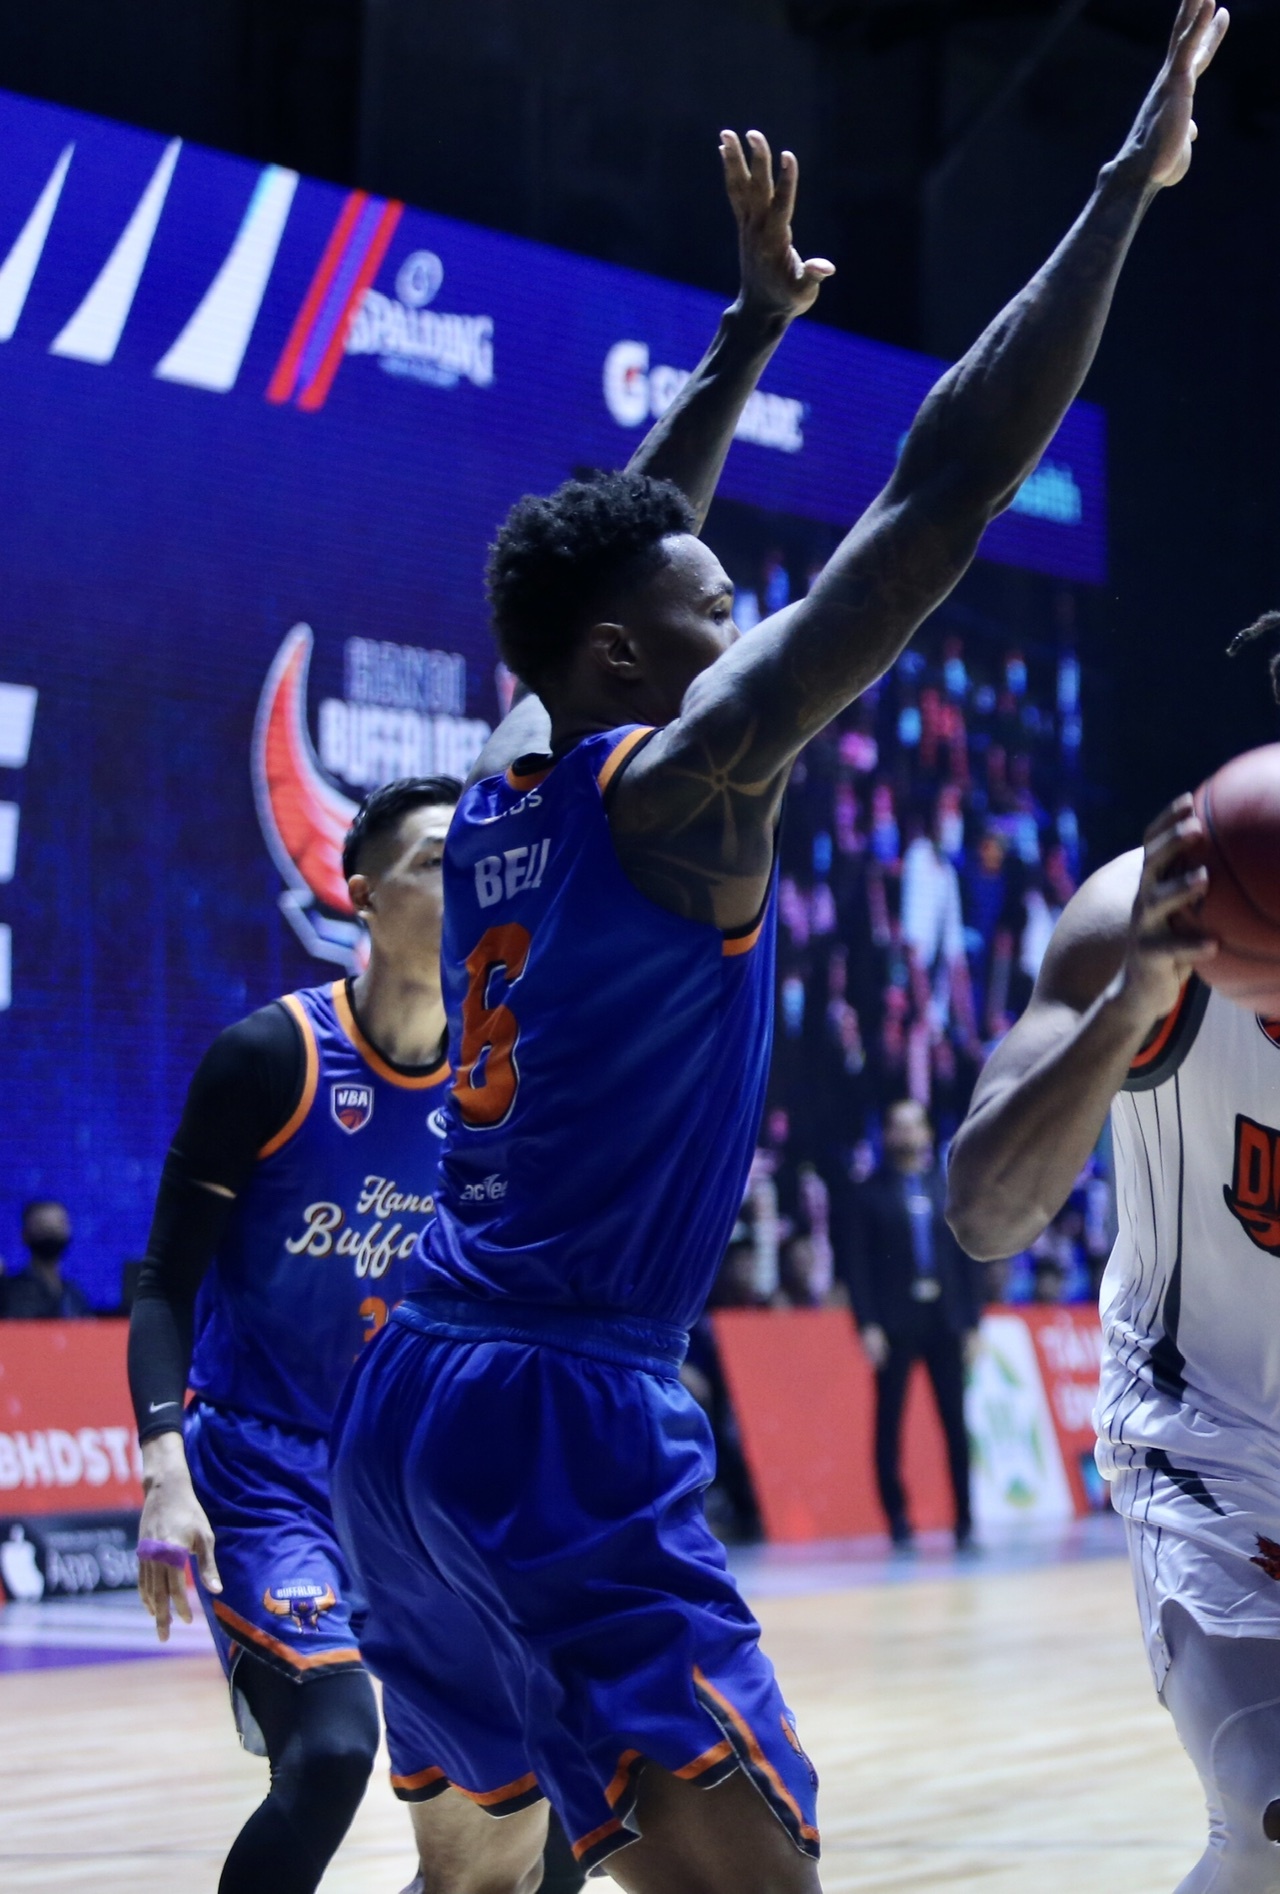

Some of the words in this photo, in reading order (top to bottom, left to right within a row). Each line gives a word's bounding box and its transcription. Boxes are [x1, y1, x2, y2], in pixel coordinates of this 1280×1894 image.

[452, 922, 532, 1132] 6
[337, 1089, 369, 1108] VBA
[356, 1174, 436, 1219] Hano
[285, 1201, 420, 1279] Buffa
